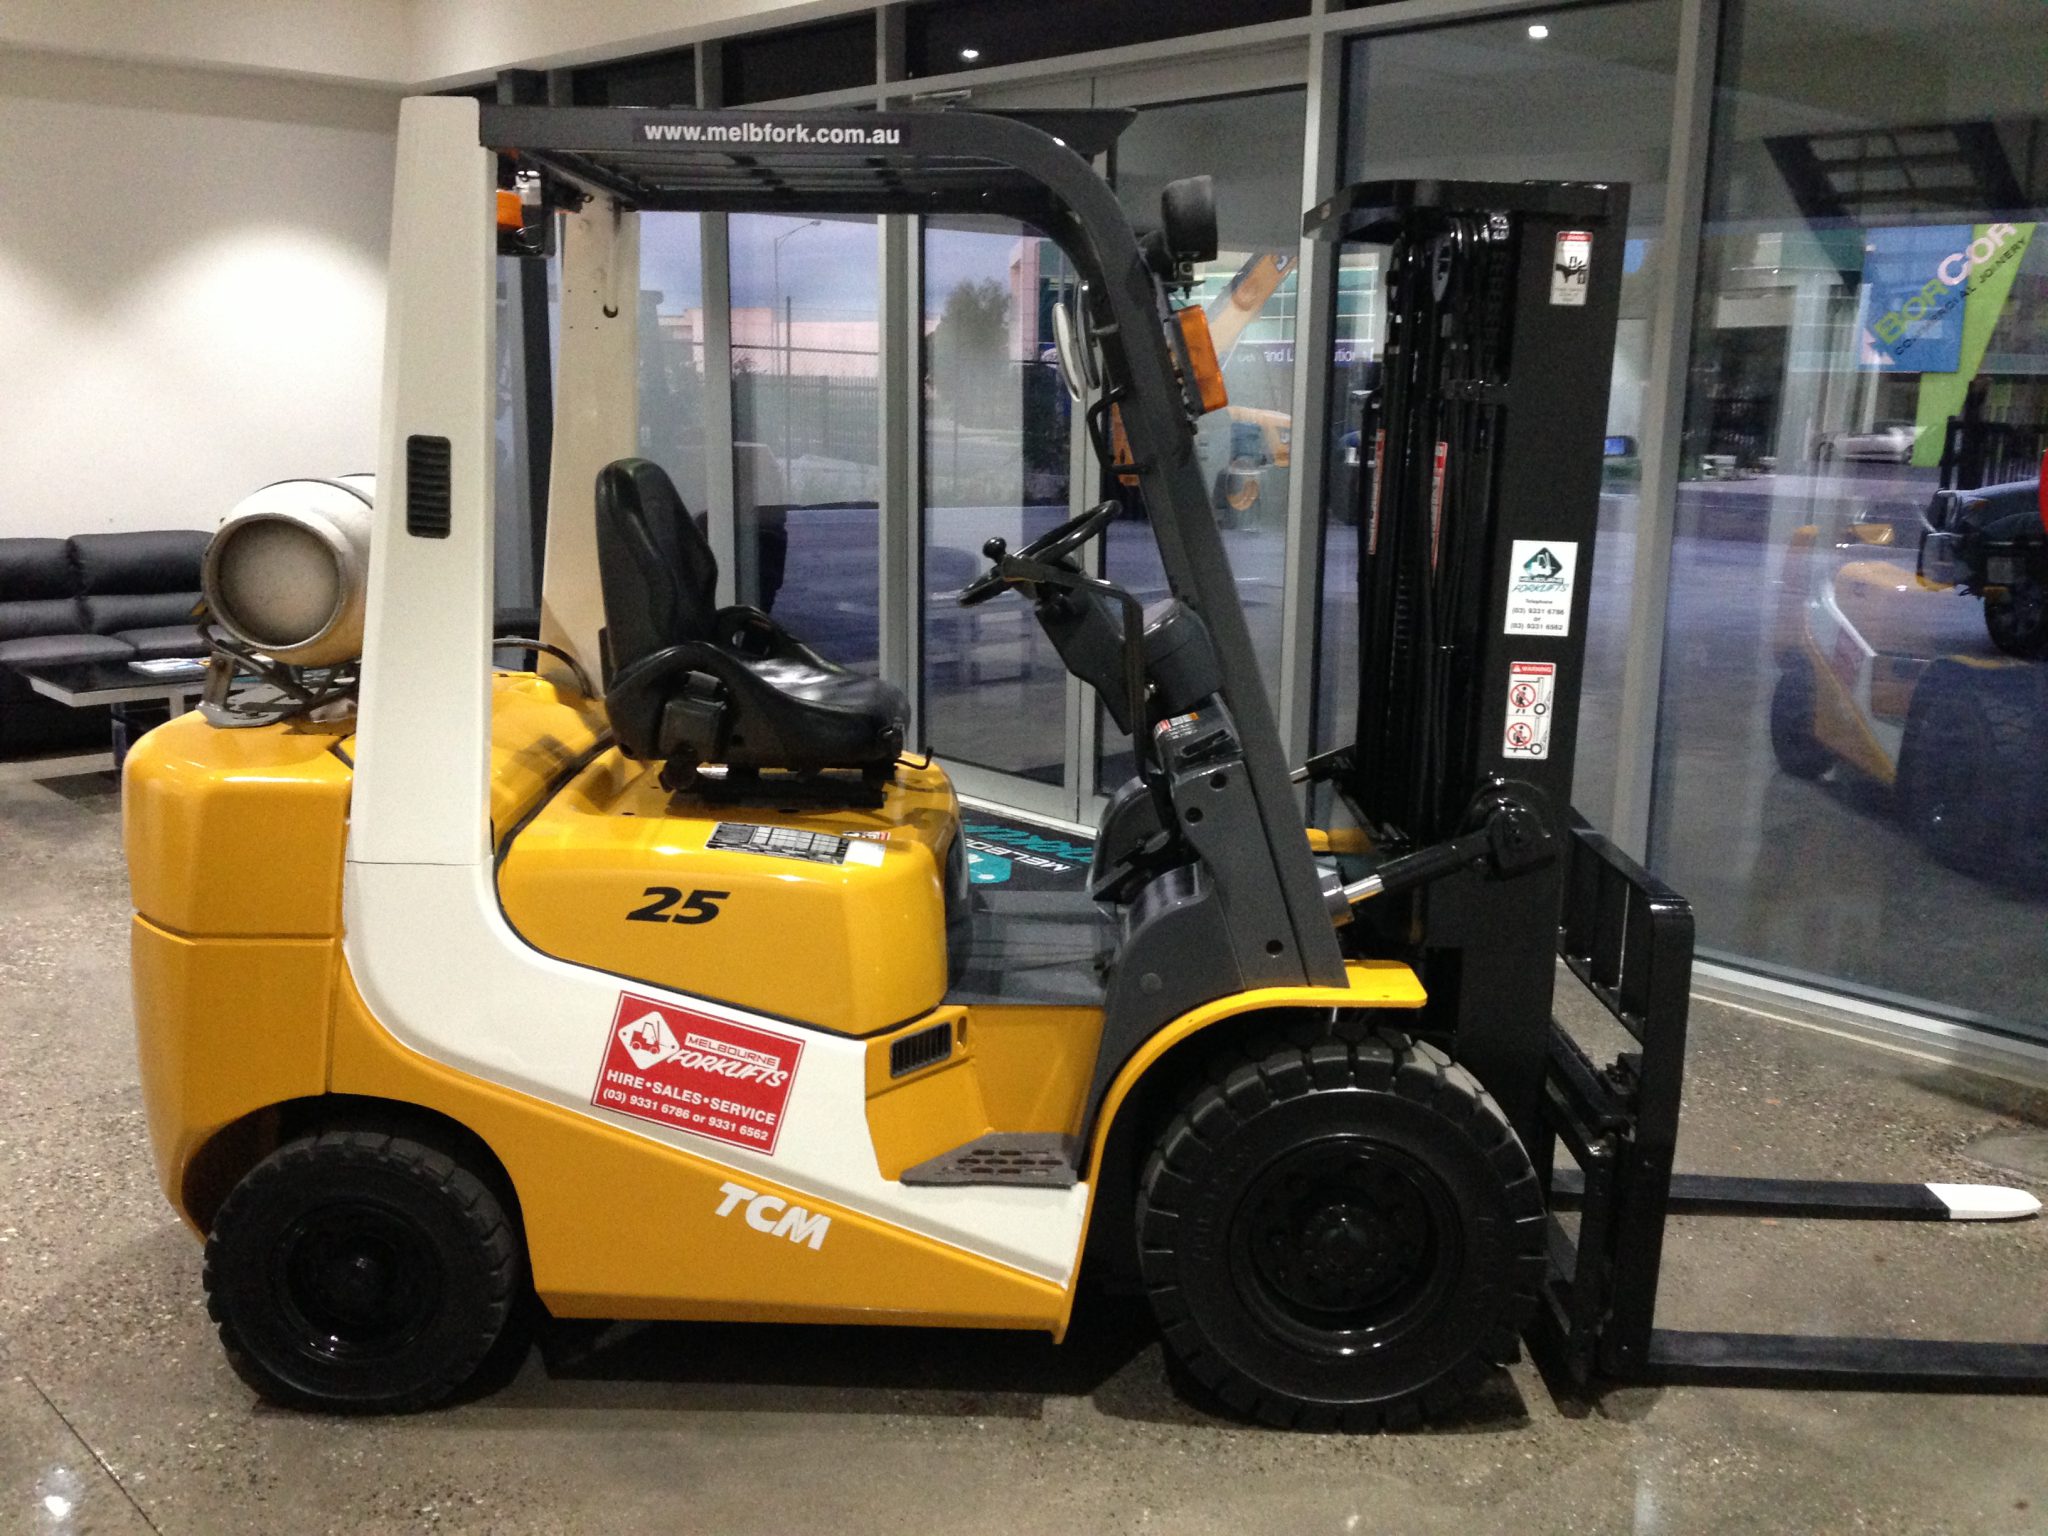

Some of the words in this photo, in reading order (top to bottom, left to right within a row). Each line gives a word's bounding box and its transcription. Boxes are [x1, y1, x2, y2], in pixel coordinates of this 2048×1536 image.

[644, 122, 900, 145] www.melbfork.com.au
[1895, 285, 1977, 356] COERCIAL
[625, 886, 731, 925] 25
[667, 1049, 789, 1088] FORKLIFTS
[686, 1035, 778, 1067] MELBOURNE
[603, 1088, 627, 1105] (03)
[630, 1095, 658, 1111] 9331
[692, 1113, 706, 1124] or
[709, 1117, 736, 1132] 9331
[739, 1125, 769, 1141] 6562
[715, 1181, 832, 1251] TCM
